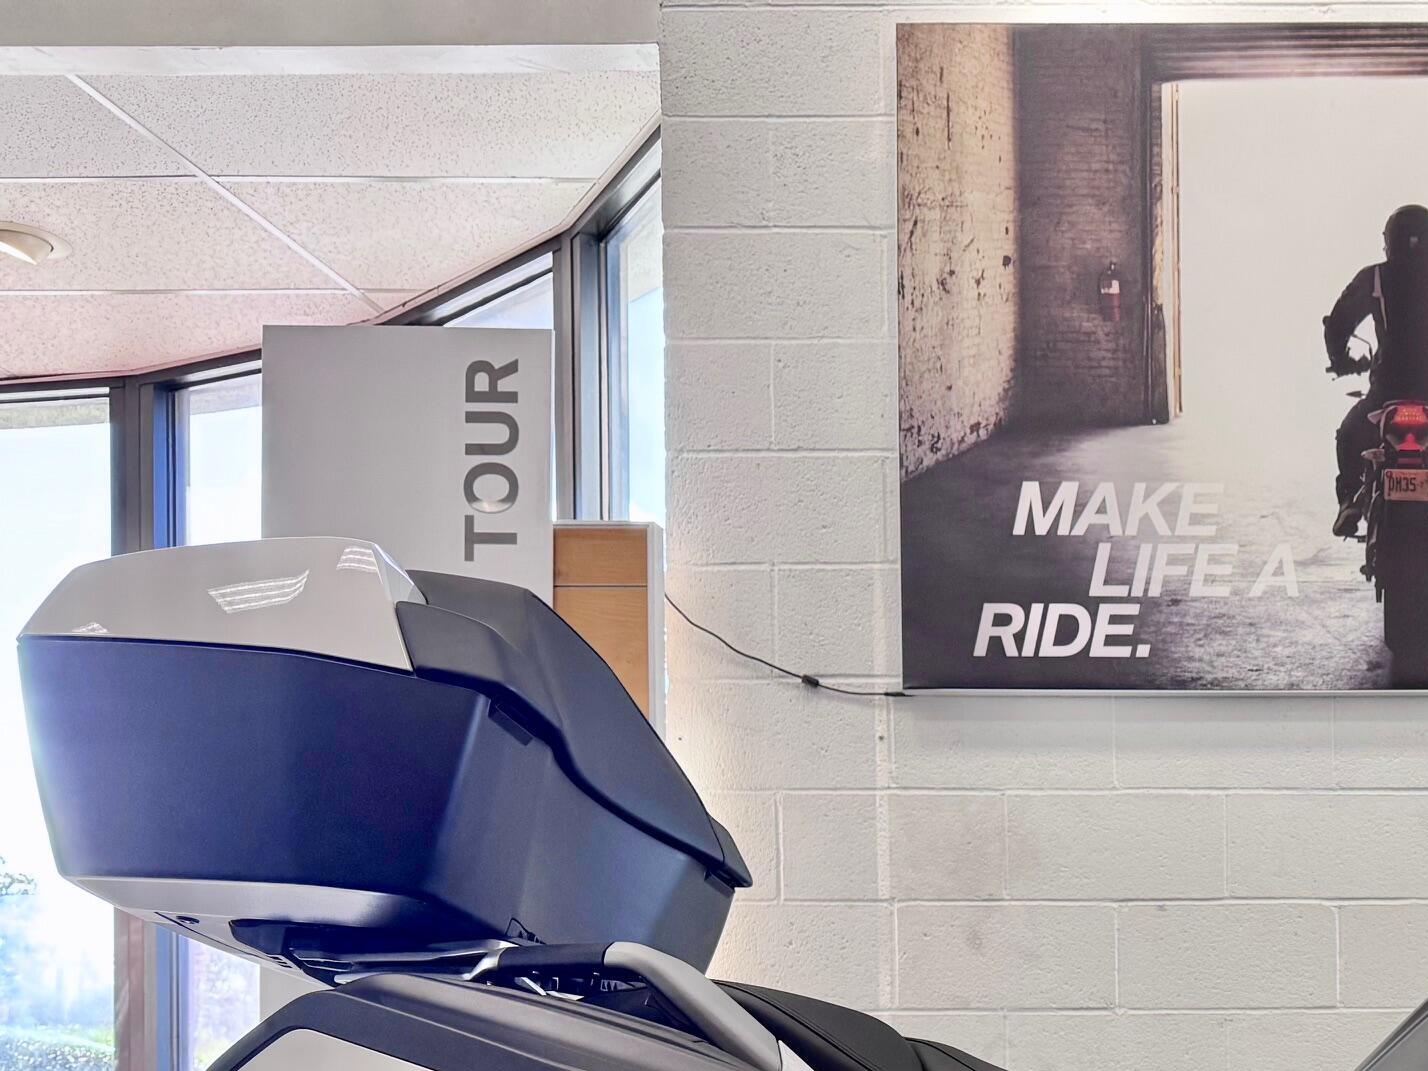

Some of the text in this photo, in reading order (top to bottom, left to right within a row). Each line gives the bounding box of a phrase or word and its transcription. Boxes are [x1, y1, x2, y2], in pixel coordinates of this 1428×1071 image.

[463, 358, 520, 562] TOUR
[1012, 481, 1225, 536] MAKE
[1088, 542, 1300, 597] LIFE A
[972, 602, 1151, 658] RIDE.
